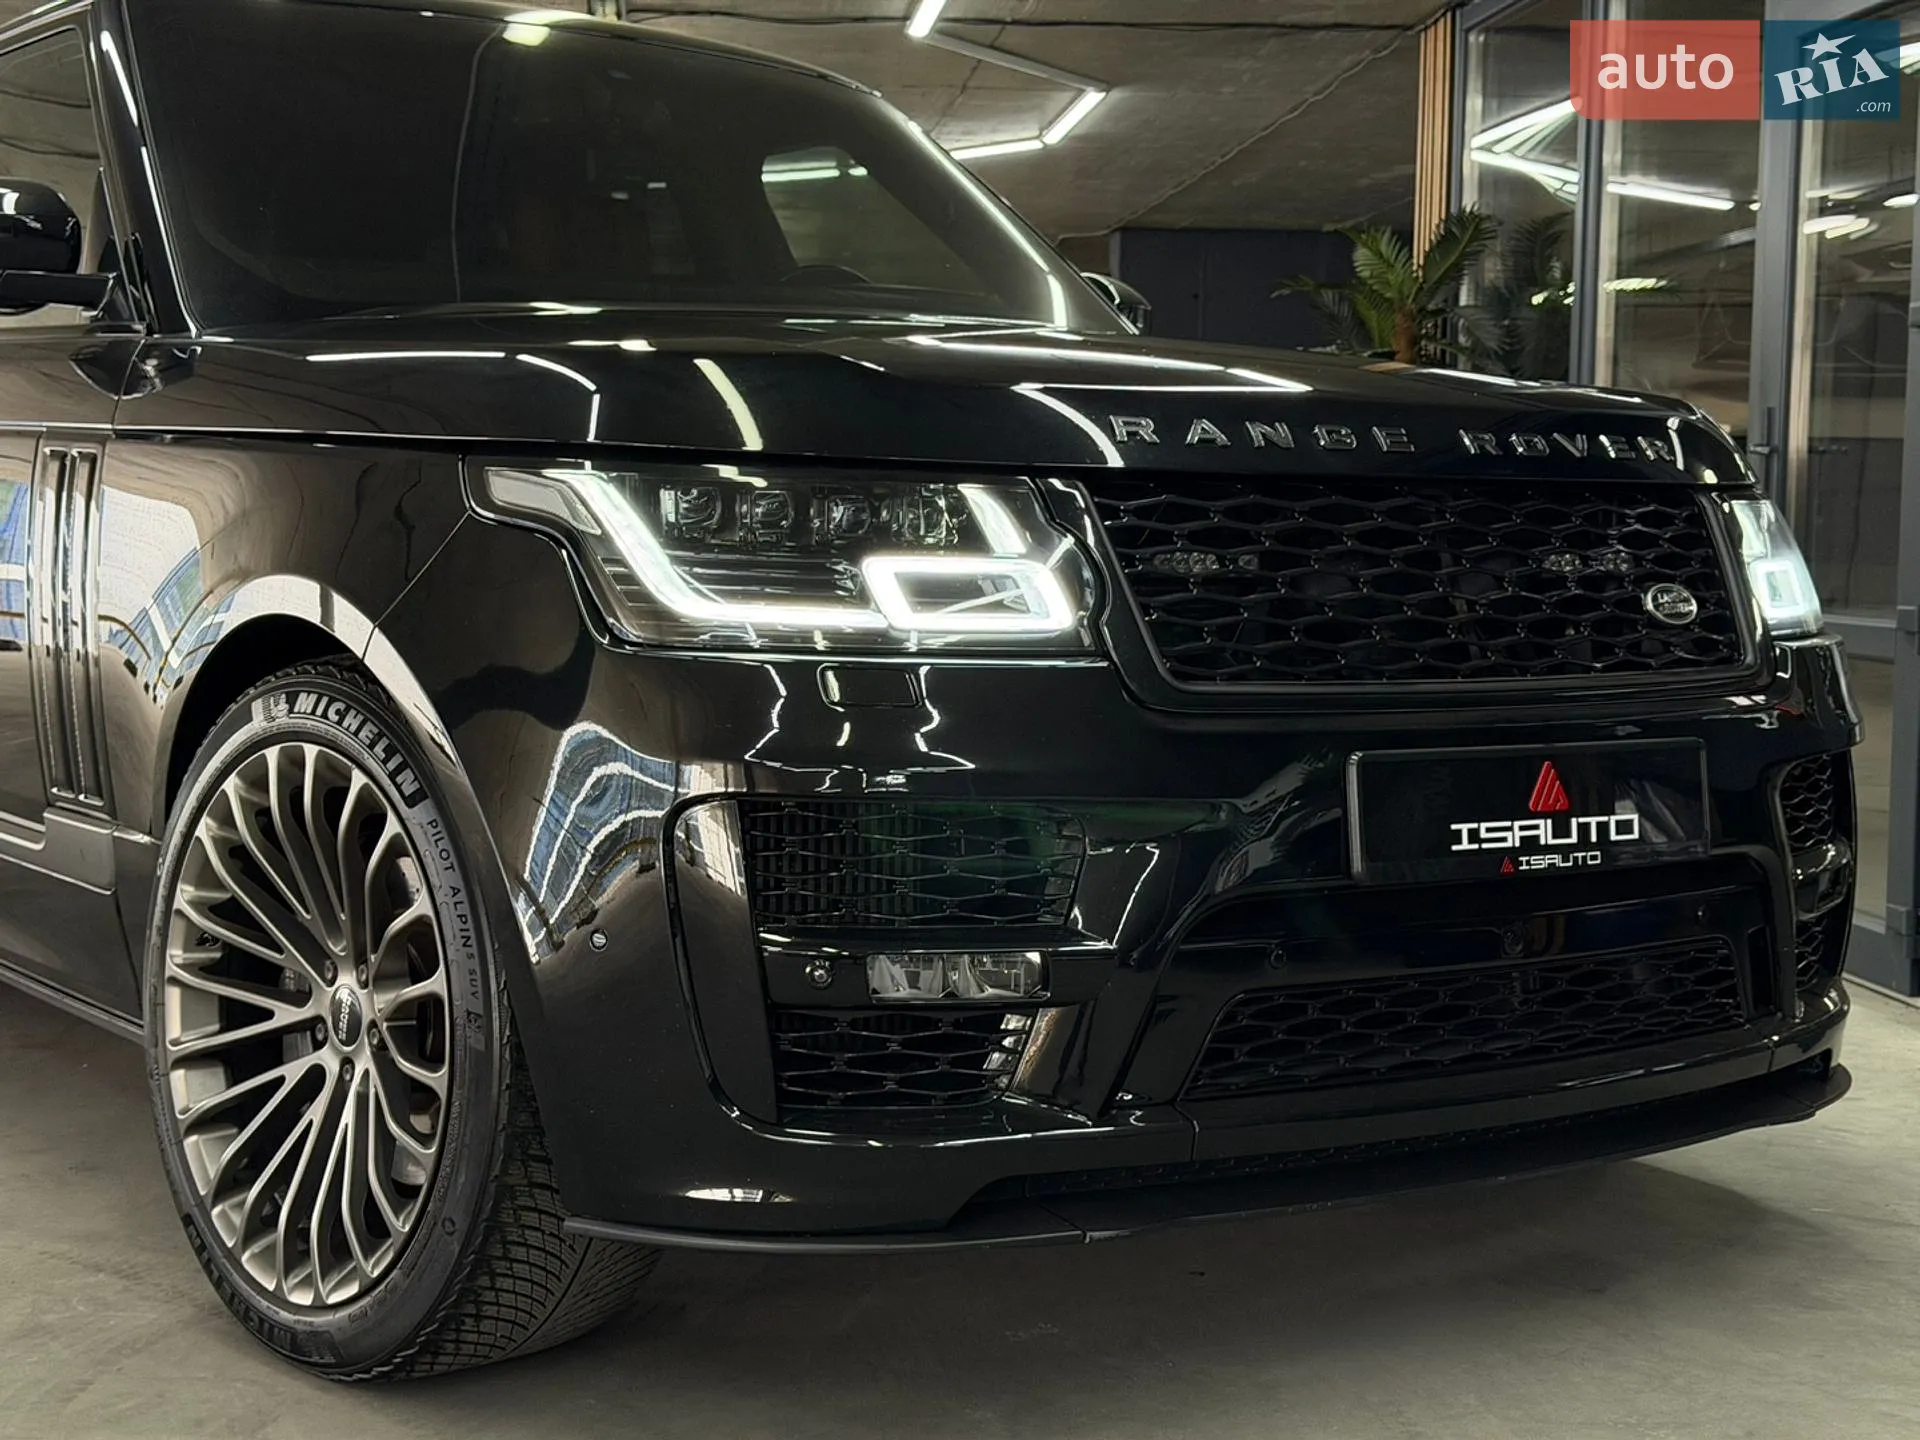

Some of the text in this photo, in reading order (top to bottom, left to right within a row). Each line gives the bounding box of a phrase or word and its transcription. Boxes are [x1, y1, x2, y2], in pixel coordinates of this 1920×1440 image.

[1109, 415, 1676, 461] RANGE ROVER
[294, 692, 421, 797] MICHELIN
[427, 819, 455, 873] PILOT
[1450, 814, 1639, 851] ISAUTO
[1518, 851, 1601, 870] ISAUTO
